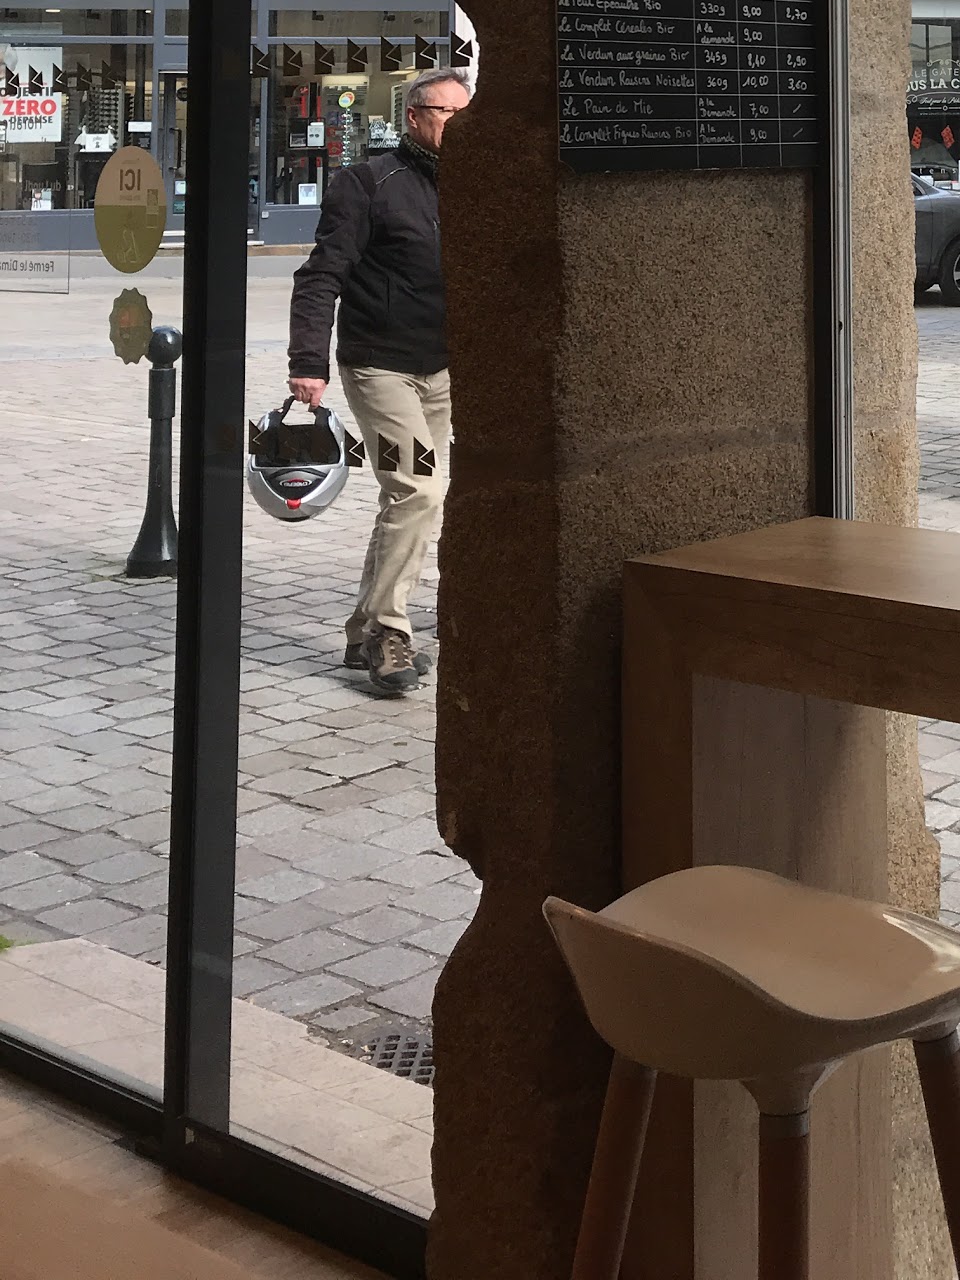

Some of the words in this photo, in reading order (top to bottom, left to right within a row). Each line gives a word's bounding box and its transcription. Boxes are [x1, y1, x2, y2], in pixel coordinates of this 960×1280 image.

[700, 2, 726, 17] 330g
[742, 5, 762, 18] 9,00
[786, 7, 808, 21] 2,70
[558, 16, 572, 32] Le
[575, 18, 612, 39] Complet
[656, 22, 675, 34] Bio
[743, 28, 763, 42] 9,00
[700, 31, 735, 44] demande
[560, 44, 575, 61] La
[579, 43, 614, 60] Verdun
[669, 48, 690, 61] Bio
[704, 49, 727, 65] 345g
[786, 53, 807, 68] 2,90
[579, 69, 616, 87] Verdun
[655, 73, 695, 87] Noisettes
[706, 76, 728, 91] 360g
[742, 75, 769, 88] 10,00
[787, 78, 808, 91] 3,60
[906, 80, 927, 93] US
[930, 79, 948, 89] LA
[562, 95, 580, 116] Le
[583, 98, 612, 114] Pain
[616, 101, 628, 114] de
[633, 99, 654, 114] Mie
[748, 102, 769, 118] 7,00
[560, 123, 573, 143] Le
[574, 126, 611, 144] Complet
[674, 126, 692, 138] Bio
[750, 128, 768, 142] 9,00
